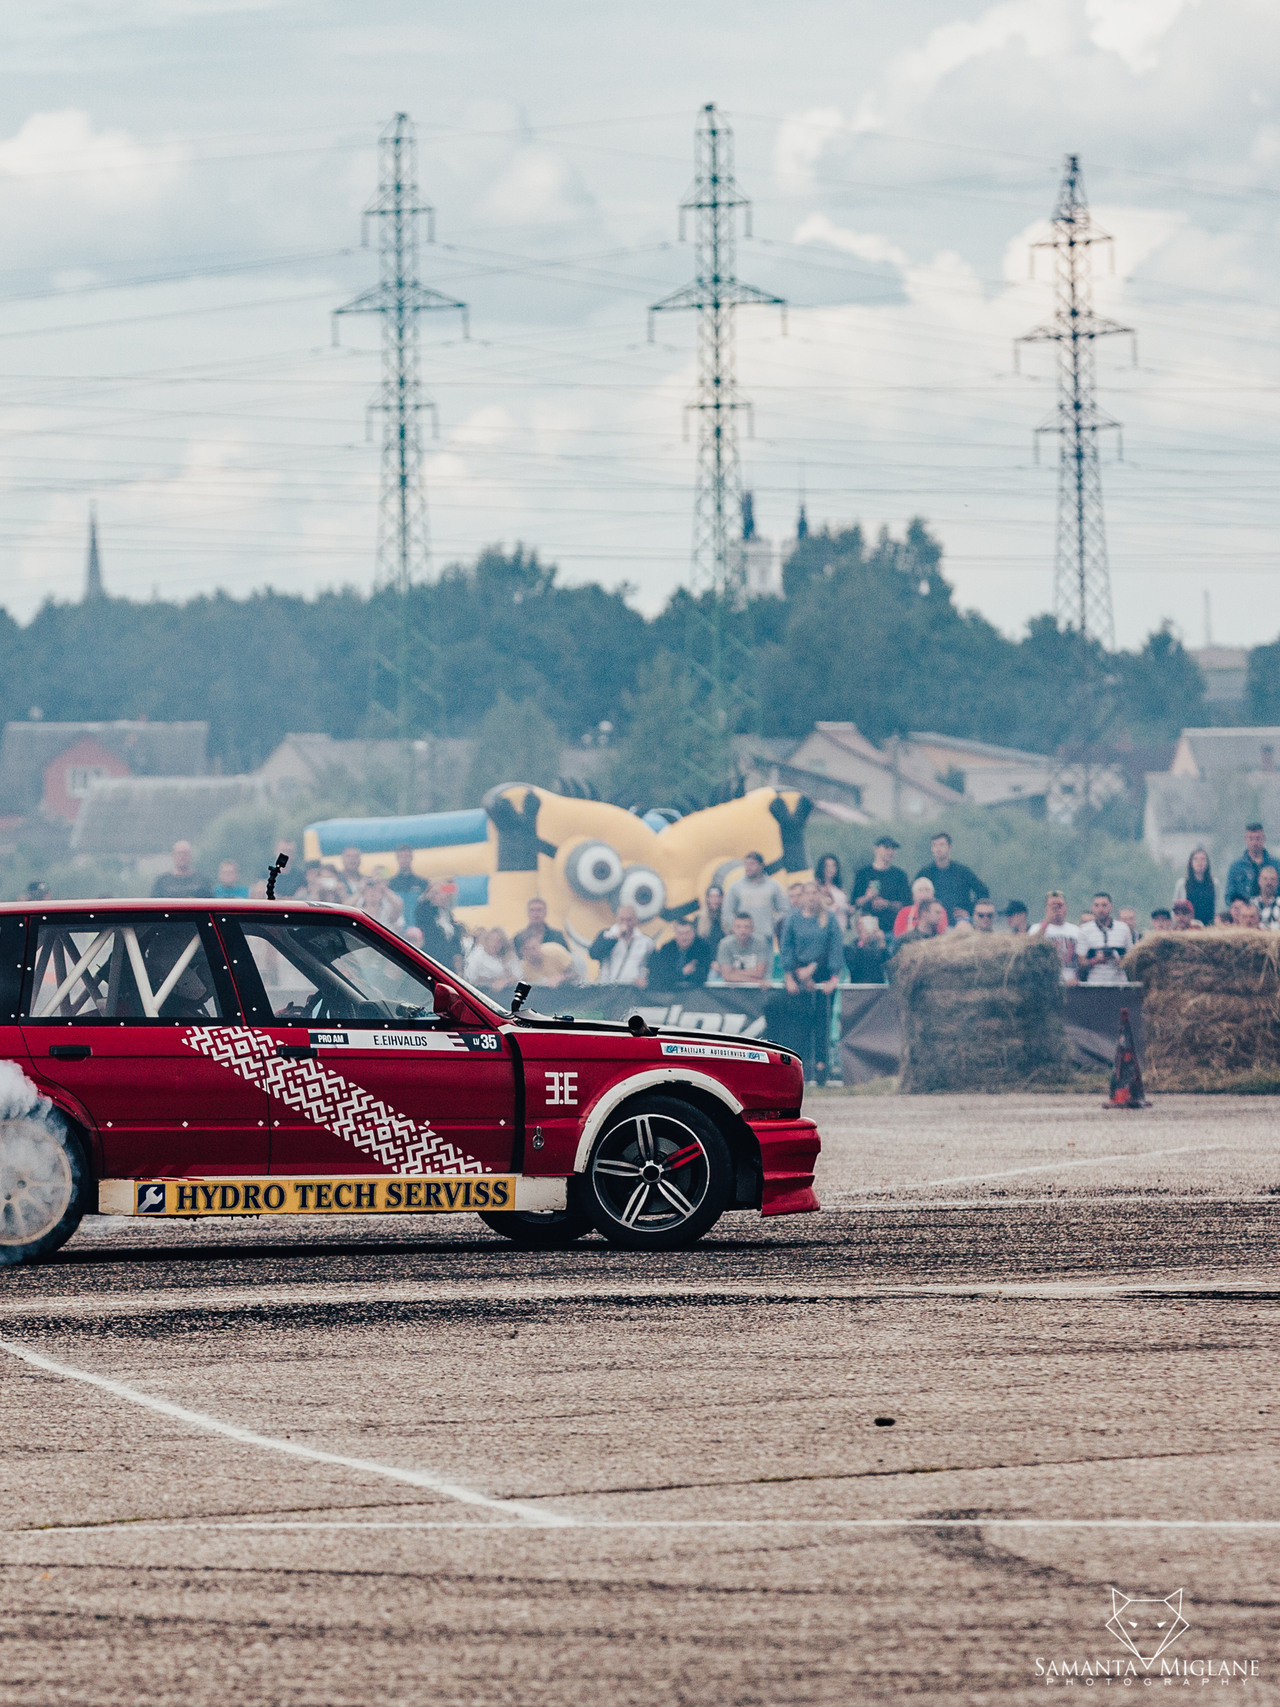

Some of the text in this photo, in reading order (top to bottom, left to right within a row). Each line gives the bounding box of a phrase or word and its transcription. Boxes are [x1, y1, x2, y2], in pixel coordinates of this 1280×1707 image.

[317, 1034, 345, 1044] PRO AM
[373, 1034, 428, 1047] E.EIHVALDS
[472, 1033, 498, 1050] LV 35
[680, 1046, 706, 1054] BALTIJAS
[710, 1048, 746, 1058] AUTOSERVISS
[176, 1180, 509, 1210] HYDRO TECH SERVISS
